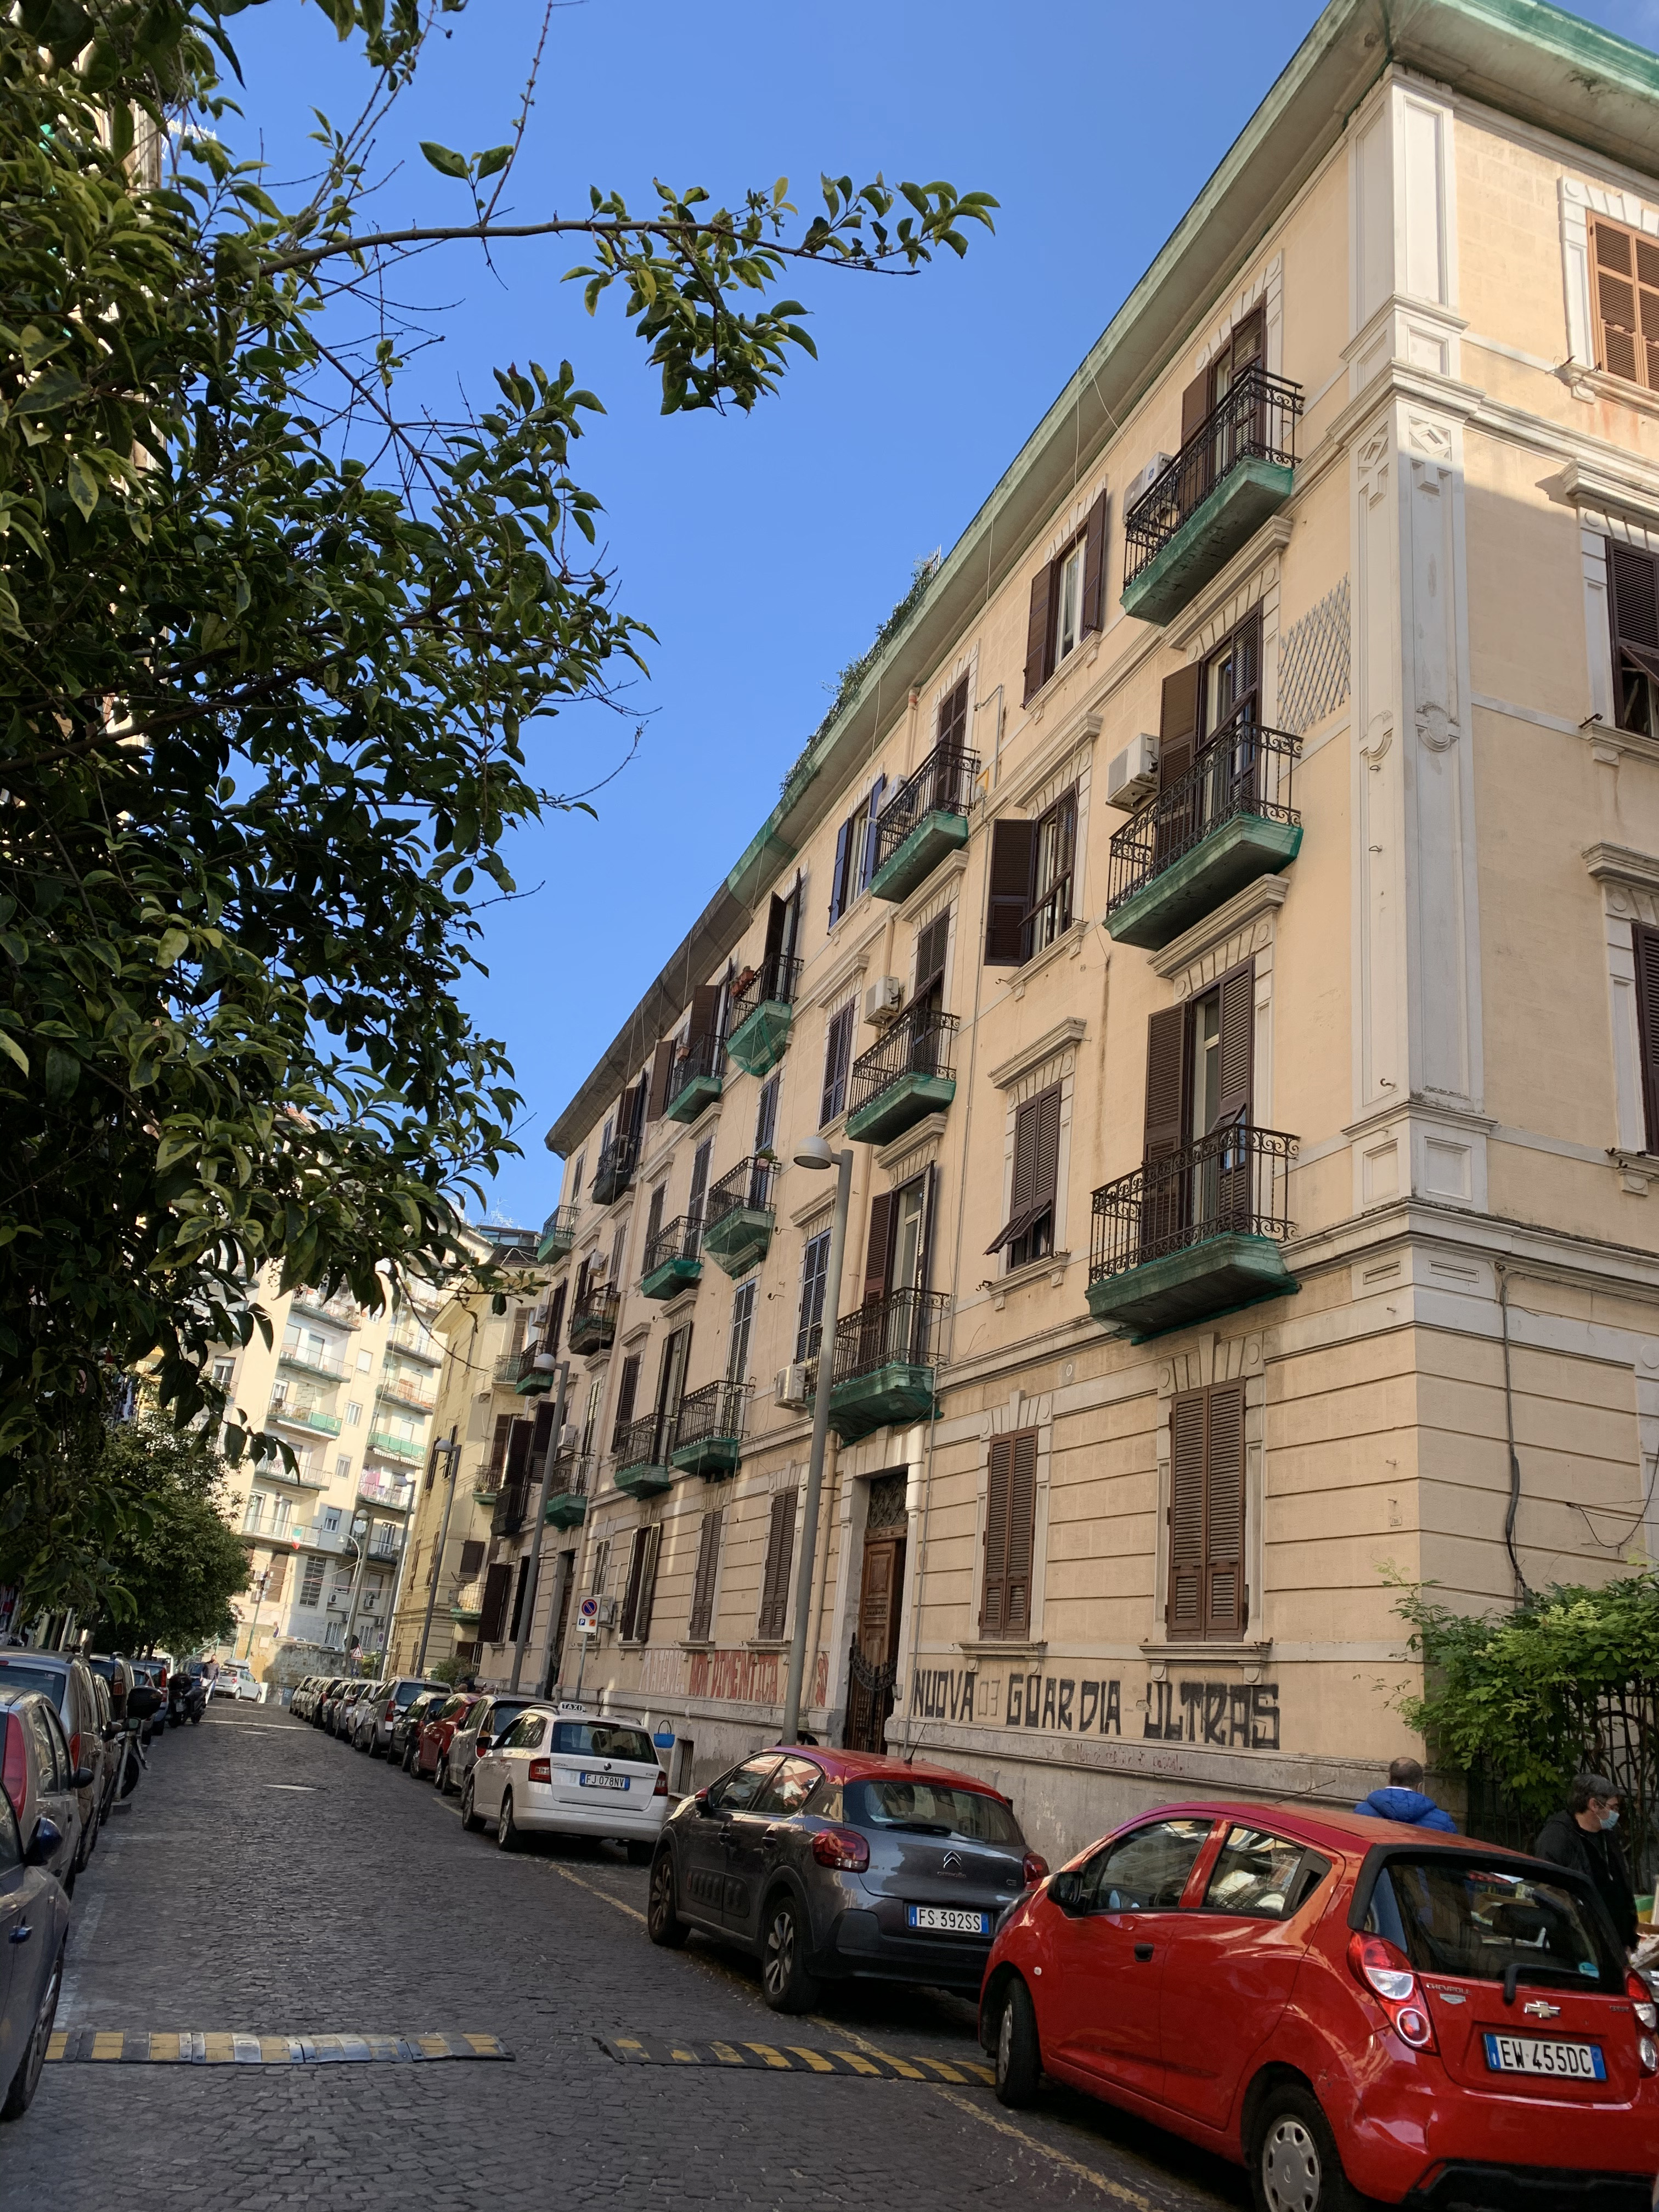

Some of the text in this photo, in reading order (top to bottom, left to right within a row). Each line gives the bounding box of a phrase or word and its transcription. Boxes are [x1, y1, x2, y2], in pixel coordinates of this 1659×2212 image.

[689, 1652, 709, 1696] NON
[710, 1650, 778, 1703] DIMENTICA
[913, 1669, 975, 1722] NUOVA
[1007, 1673, 1121, 1735] GUARDIA
[1144, 1681, 1280, 1750] ULTRAS
[586, 1775, 597, 1784] FJ
[599, 1776, 624, 1787] 078NV
[918, 1909, 935, 1926] FS
[940, 1911, 980, 1931] 392SS
[1500, 2040, 1525, 2069] EW
[1532, 2043, 1592, 2075] 455DC
